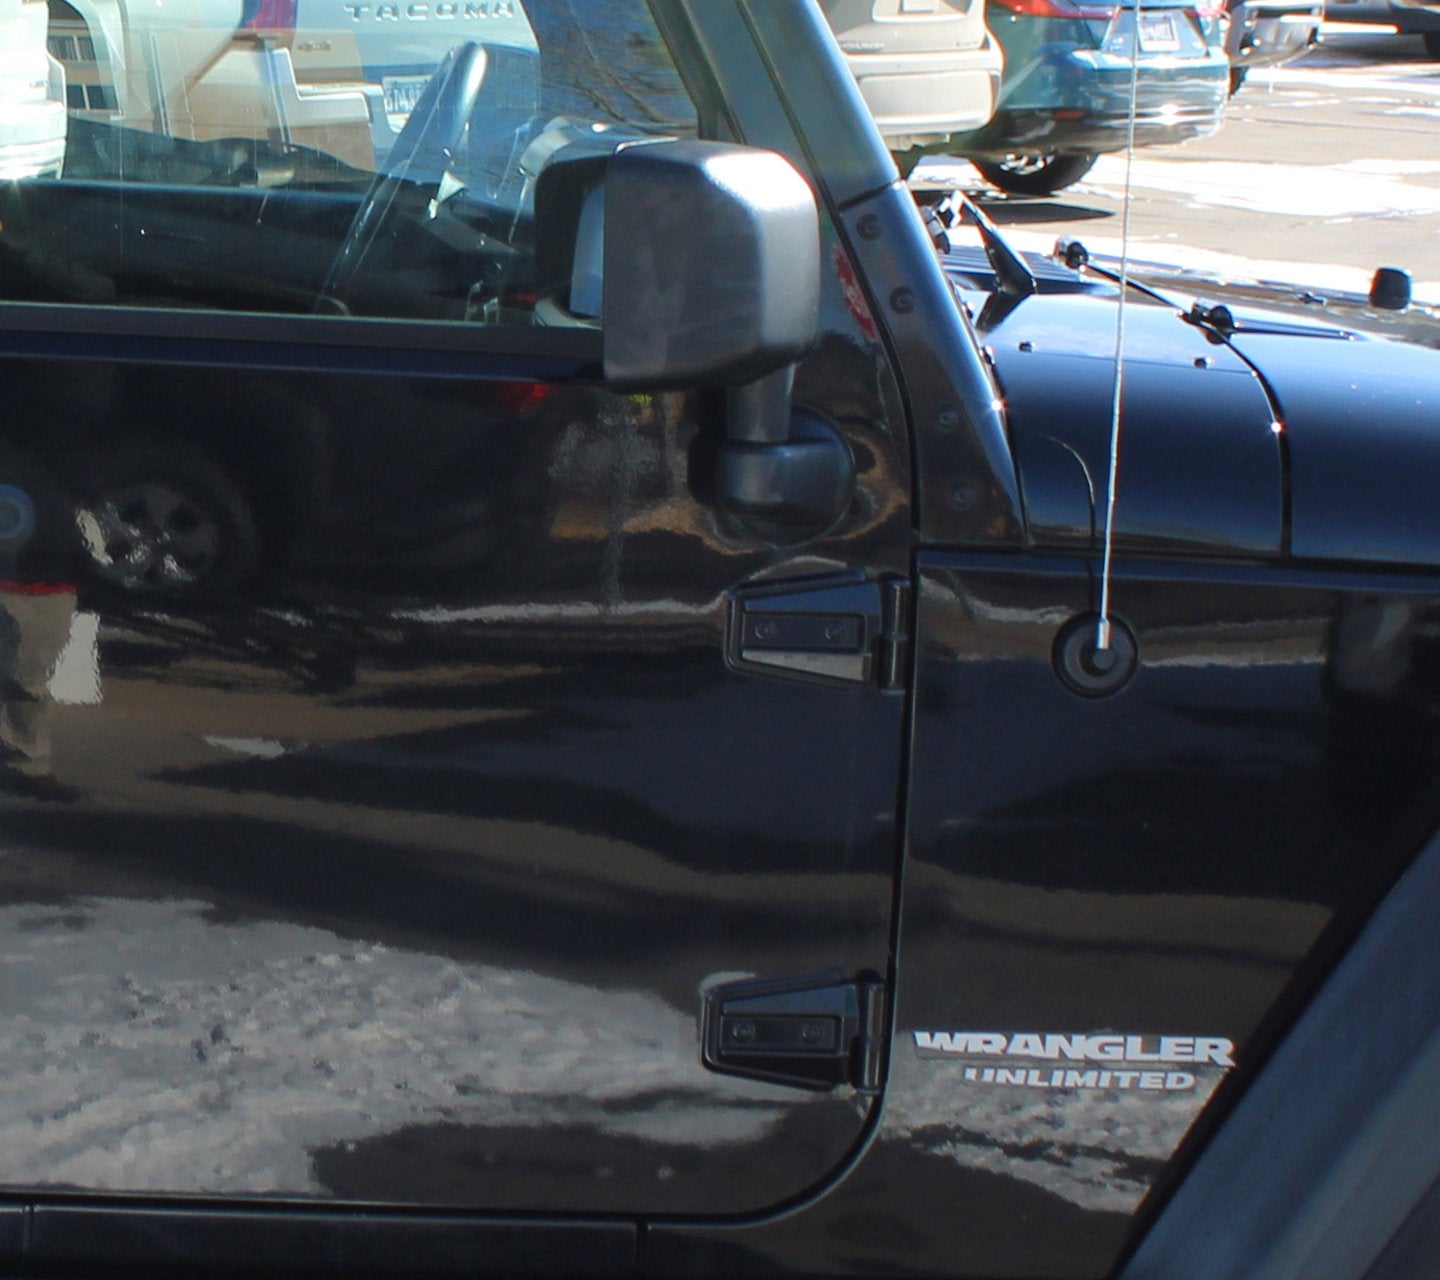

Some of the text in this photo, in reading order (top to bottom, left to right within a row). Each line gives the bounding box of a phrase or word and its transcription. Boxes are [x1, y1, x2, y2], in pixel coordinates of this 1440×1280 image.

[343, 1, 515, 23] TACOMA
[914, 1030, 1236, 1067] WRANGLER
[964, 1066, 1197, 1090] UNLIMITED
